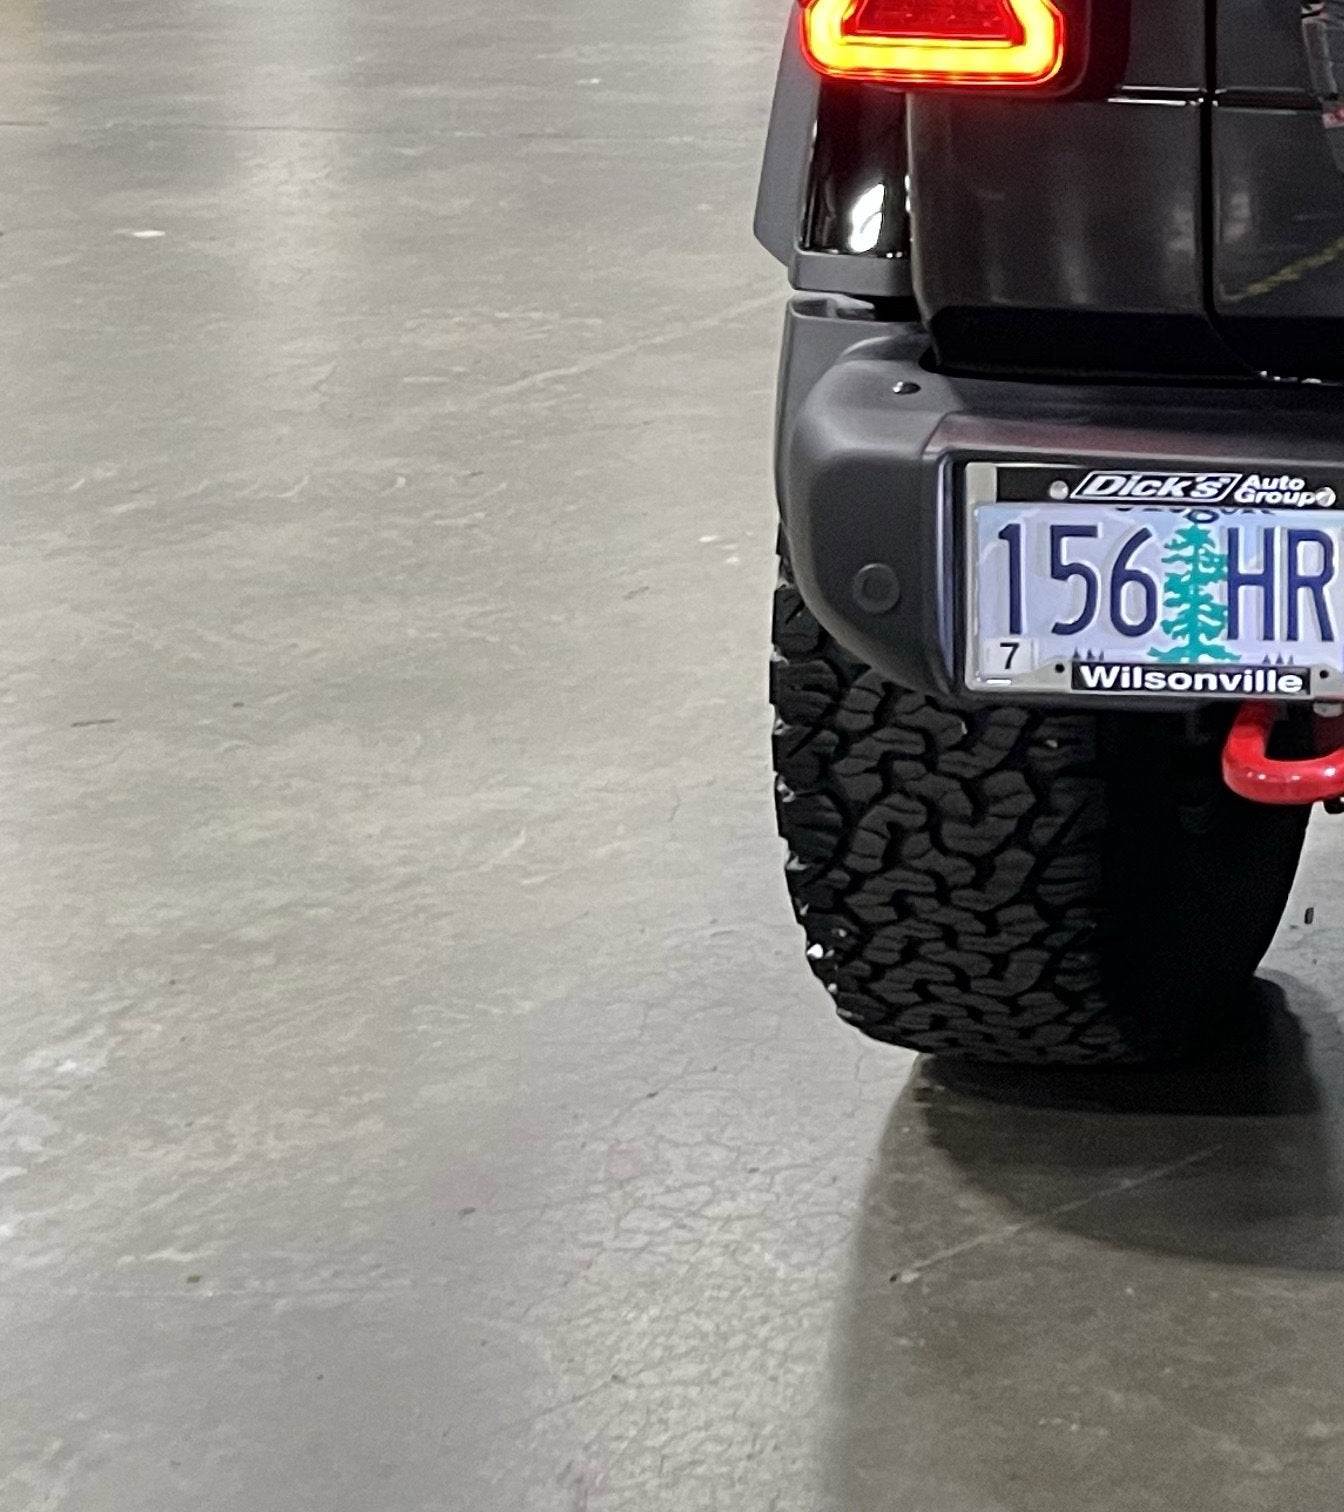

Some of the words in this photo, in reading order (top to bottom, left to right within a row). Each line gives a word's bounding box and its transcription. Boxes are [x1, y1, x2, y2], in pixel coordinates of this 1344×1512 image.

[1240, 474, 1305, 491] Auto
[1233, 489, 1316, 508] Group
[998, 523, 1158, 638] 156
[1000, 642, 1020, 670] 7
[1080, 663, 1303, 695] Wilsonville
